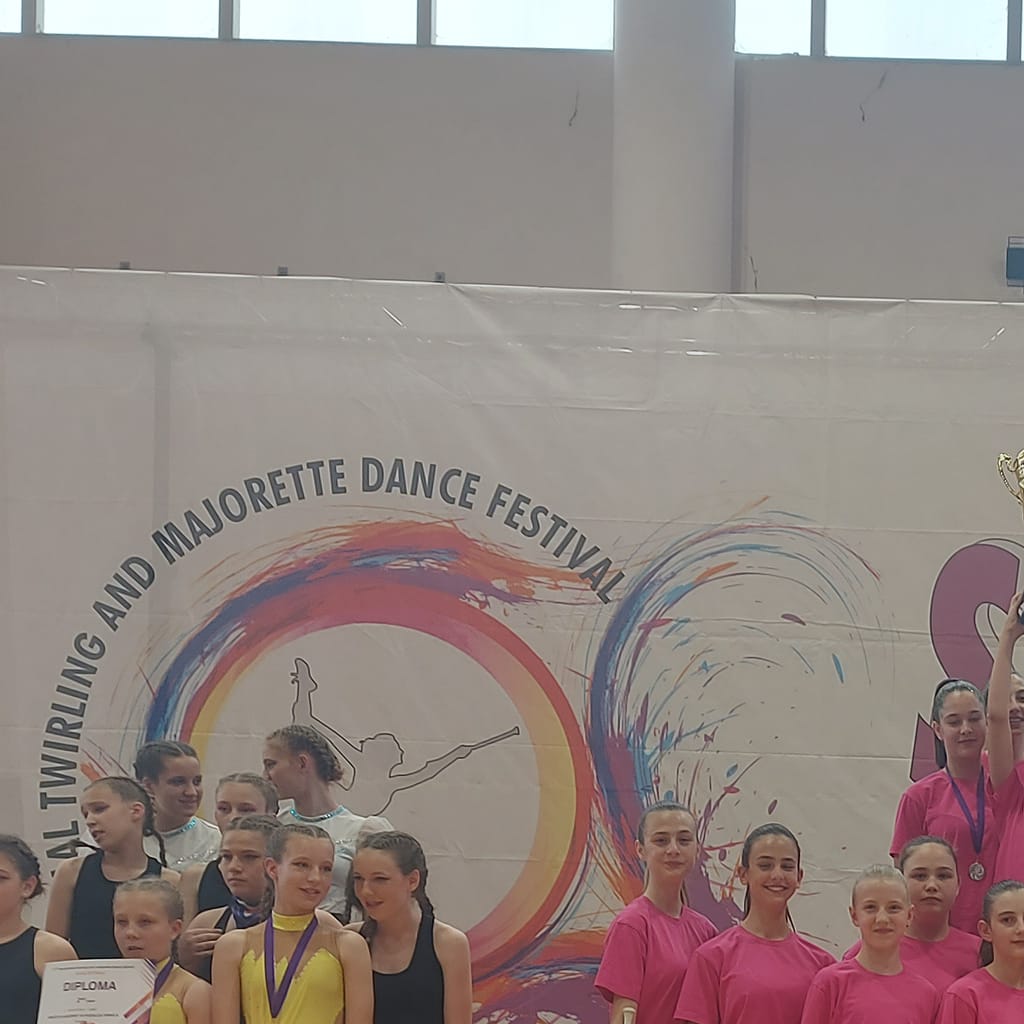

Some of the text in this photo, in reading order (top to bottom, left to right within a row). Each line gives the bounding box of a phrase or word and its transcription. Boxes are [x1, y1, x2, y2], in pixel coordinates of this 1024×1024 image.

[39, 456, 626, 878] AL TWIRLING AND MAJORETTE DANCE FESTIVAL
[63, 981, 117, 992] DIPLOMA
